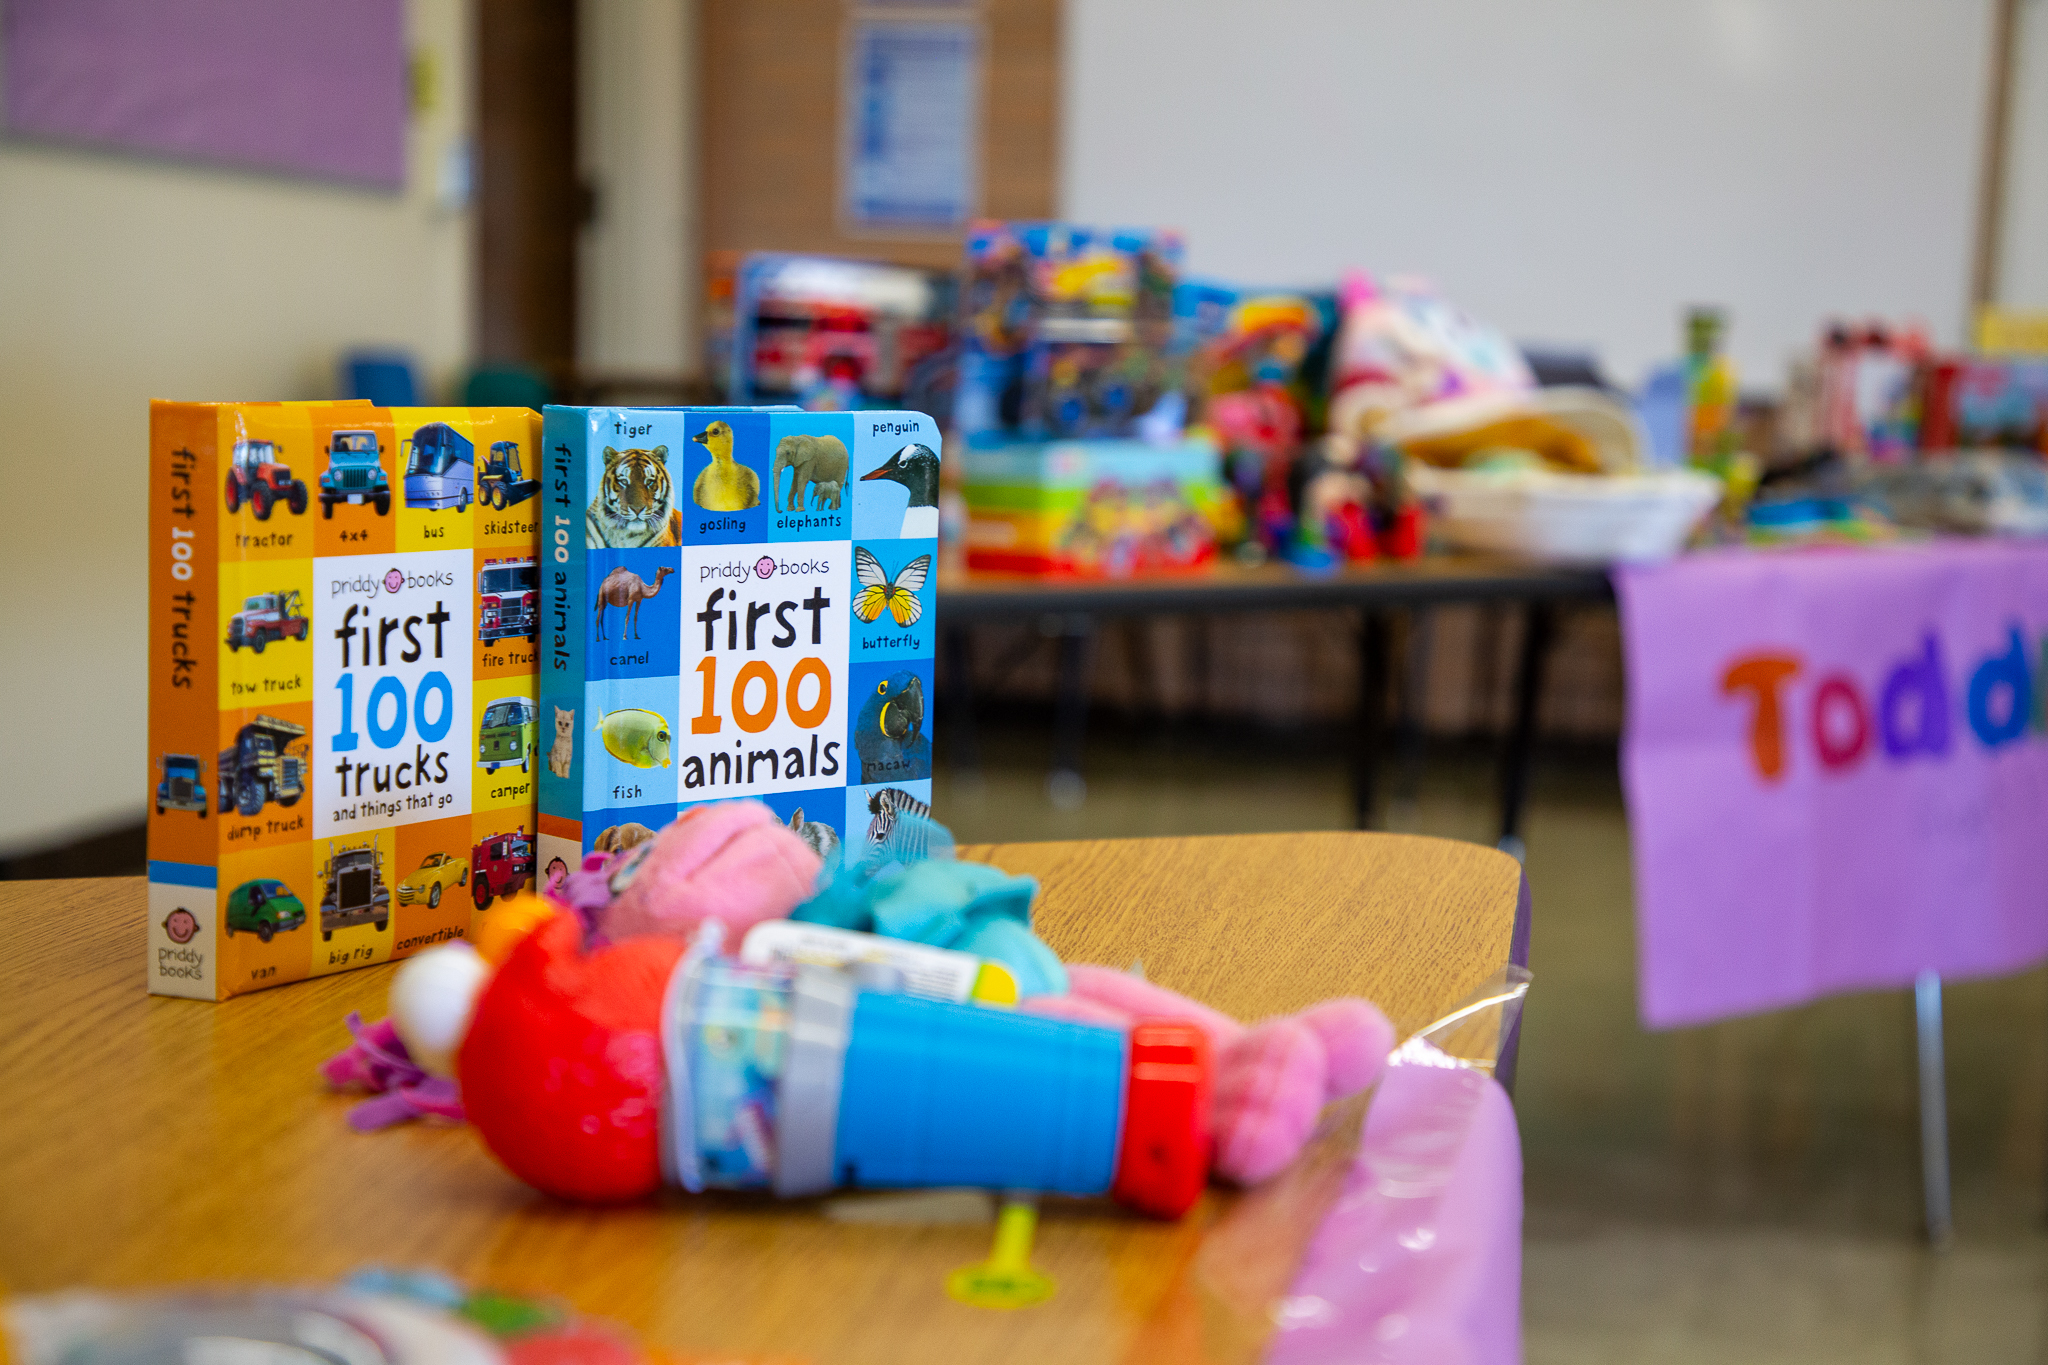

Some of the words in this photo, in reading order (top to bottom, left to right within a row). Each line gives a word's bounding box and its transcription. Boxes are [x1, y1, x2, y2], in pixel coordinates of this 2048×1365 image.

[614, 421, 653, 439] tiger
[872, 420, 920, 437] penguin
[171, 447, 197, 518] first
[554, 443, 572, 507] first
[423, 524, 445, 540] bus
[484, 520, 539, 535] skidsteer
[699, 517, 746, 535] gosling
[776, 514, 842, 532] elephants
[235, 532, 294, 549] tractor
[339, 529, 368, 543] 4x4
[554, 515, 571, 564] 100
[171, 526, 194, 581] 100
[699, 562, 750, 583] priddy
[780, 558, 830, 575] books
[331, 572, 381, 599] priddy
[407, 570, 454, 590] books
[554, 571, 571, 671] animals
[696, 586, 831, 652] first
[171, 591, 198, 690] trucks
[334, 600, 450, 669] first
[862, 635, 920, 650] butterfly
[482, 653, 504, 667] fire
[508, 651, 539, 664] truck
[609, 650, 649, 666] camel
[231, 680, 257, 696] tow
[264, 674, 301, 692] truck
[690, 655, 832, 735] 100
[331, 670, 453, 752] 100
[335, 744, 450, 798] trucks
[682, 734, 841, 789] animals
[867, 760, 910, 772] macaw
[490, 781, 531, 800] camper
[612, 785, 643, 800] fish
[332, 805, 357, 822] and
[360, 798, 402, 819] things
[405, 793, 434, 810] that
[437, 793, 453, 809] go
[227, 821, 261, 841] dump
[266, 816, 304, 834] truck
[397, 926, 464, 950] convertible
[158, 947, 203, 968] priddy
[328, 950, 349, 966] big
[353, 945, 373, 963] rig
[159, 964, 202, 980] books
[251, 966, 276, 980] van
